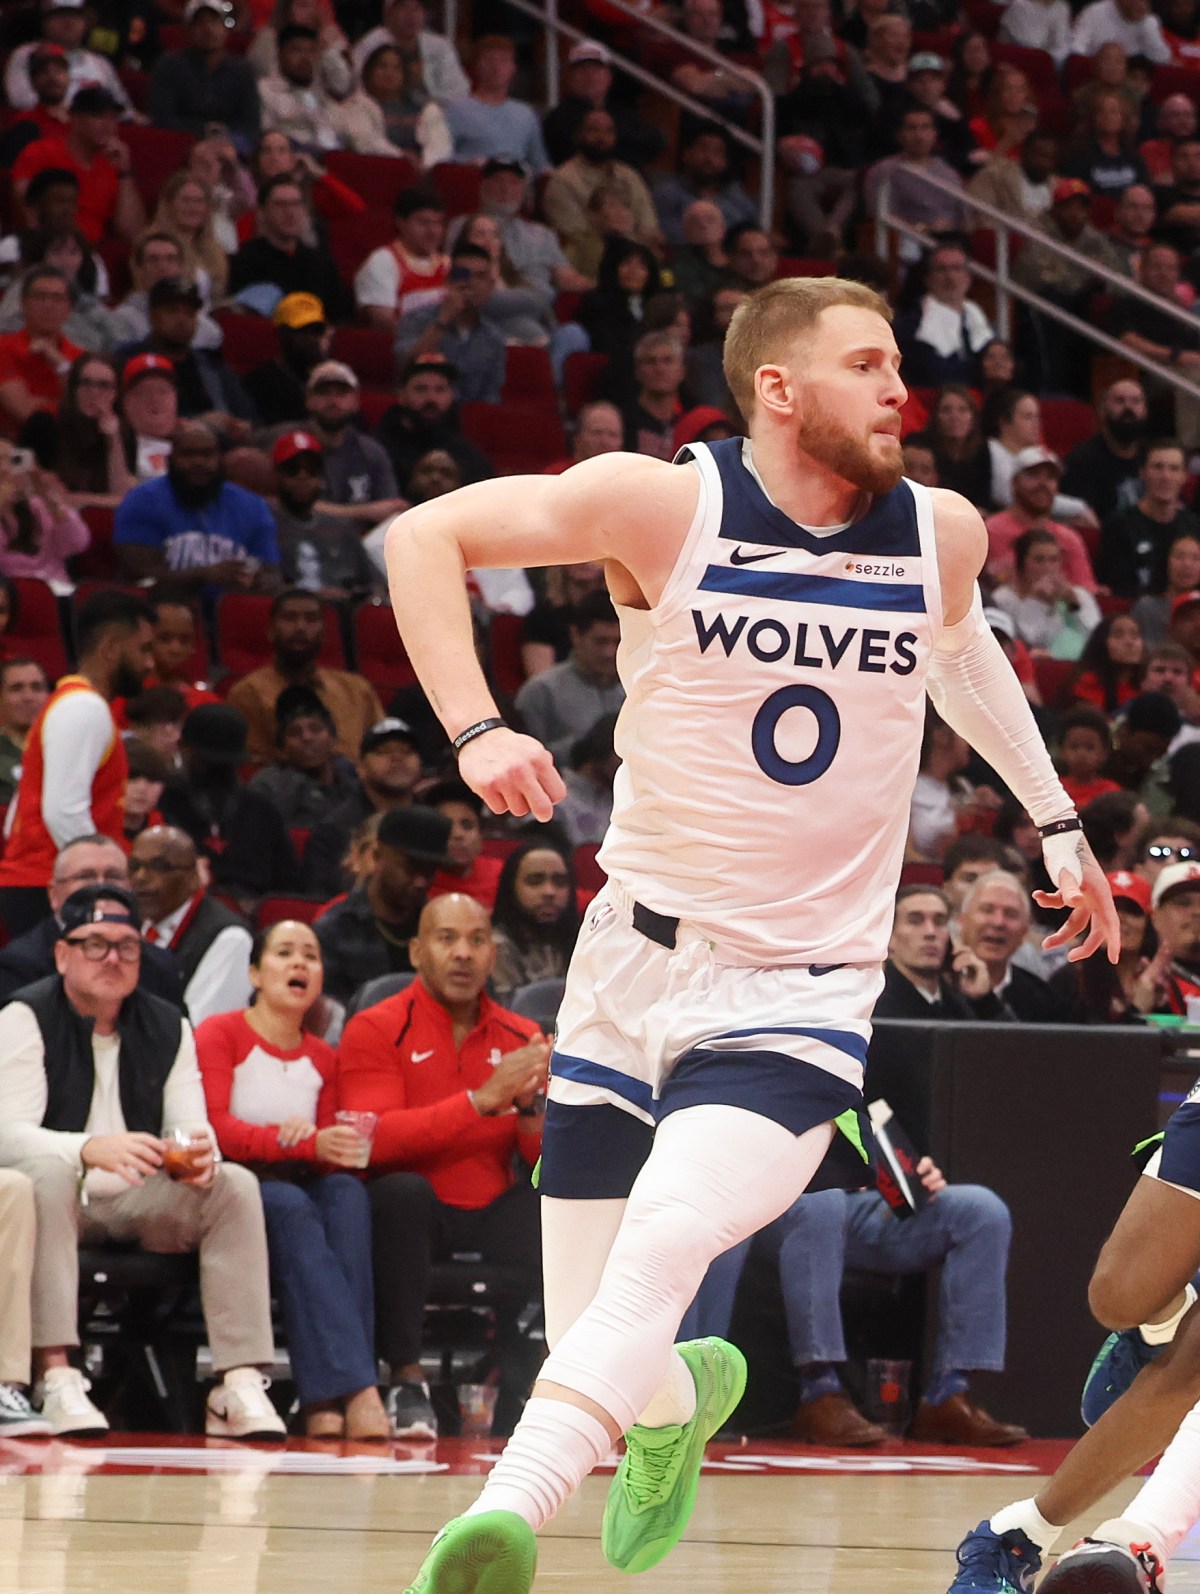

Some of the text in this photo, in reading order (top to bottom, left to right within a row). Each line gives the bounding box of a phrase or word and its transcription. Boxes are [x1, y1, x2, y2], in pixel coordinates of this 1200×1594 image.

[855, 563, 905, 577] sezzle
[691, 608, 919, 676] WOLVES
[751, 683, 841, 787] 0
